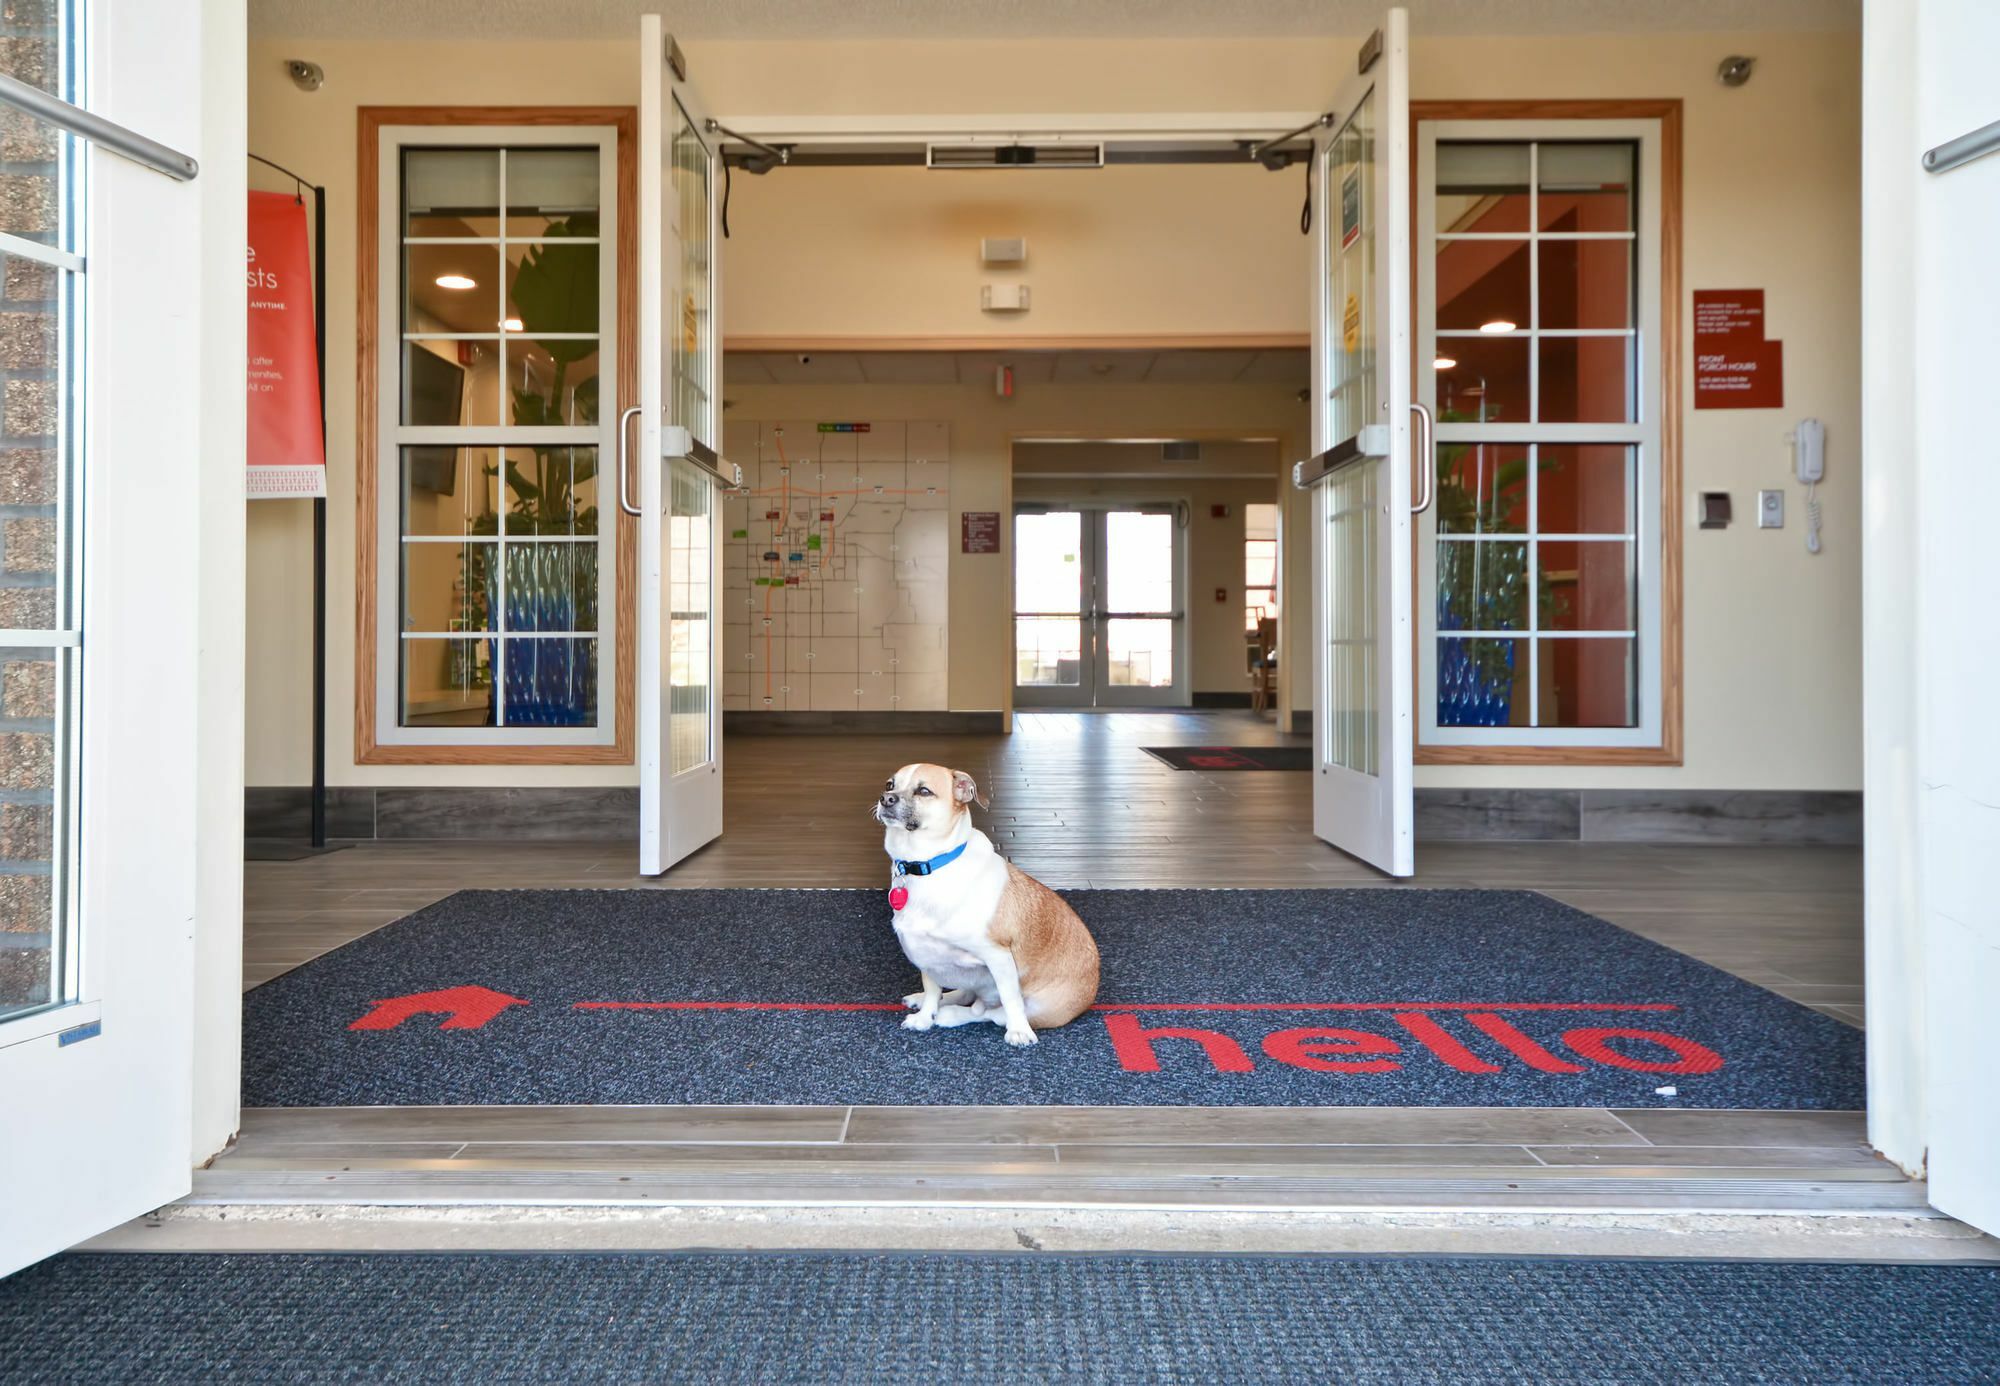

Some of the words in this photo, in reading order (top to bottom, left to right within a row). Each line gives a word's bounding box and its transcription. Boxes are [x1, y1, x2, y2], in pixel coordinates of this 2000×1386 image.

[250, 301, 287, 310] ANYTIME.
[253, 356, 273, 366] after
[1104, 1012, 1725, 1074] hello
